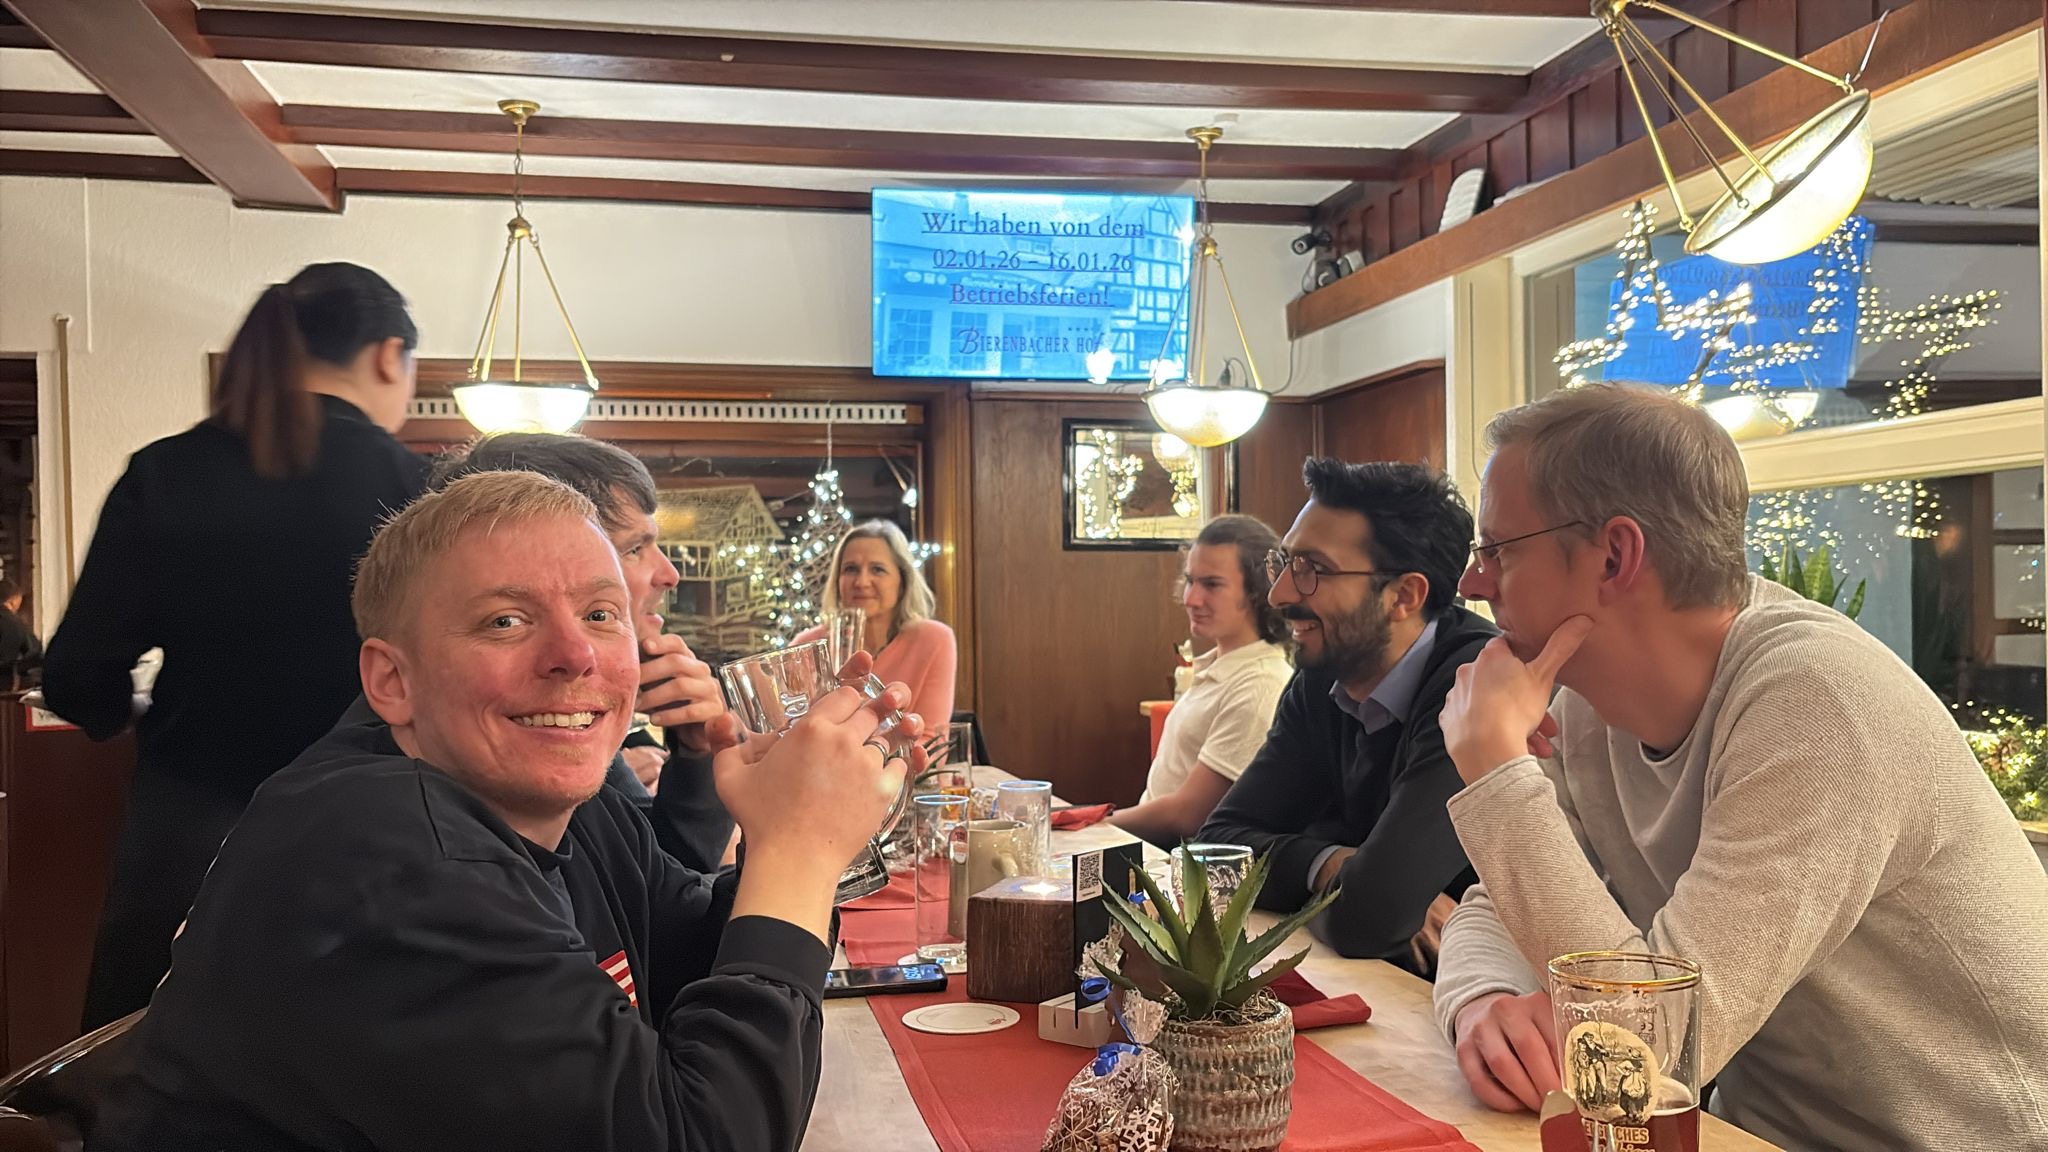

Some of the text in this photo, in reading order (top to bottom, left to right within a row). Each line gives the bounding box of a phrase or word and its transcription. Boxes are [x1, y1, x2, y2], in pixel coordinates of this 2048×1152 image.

[922, 211, 1144, 237] Wir haben von dem
[932, 248, 1022, 269] 02.01.26
[1047, 252, 1133, 272] 16.01.26
[951, 283, 1109, 306] Betriebsferien!
